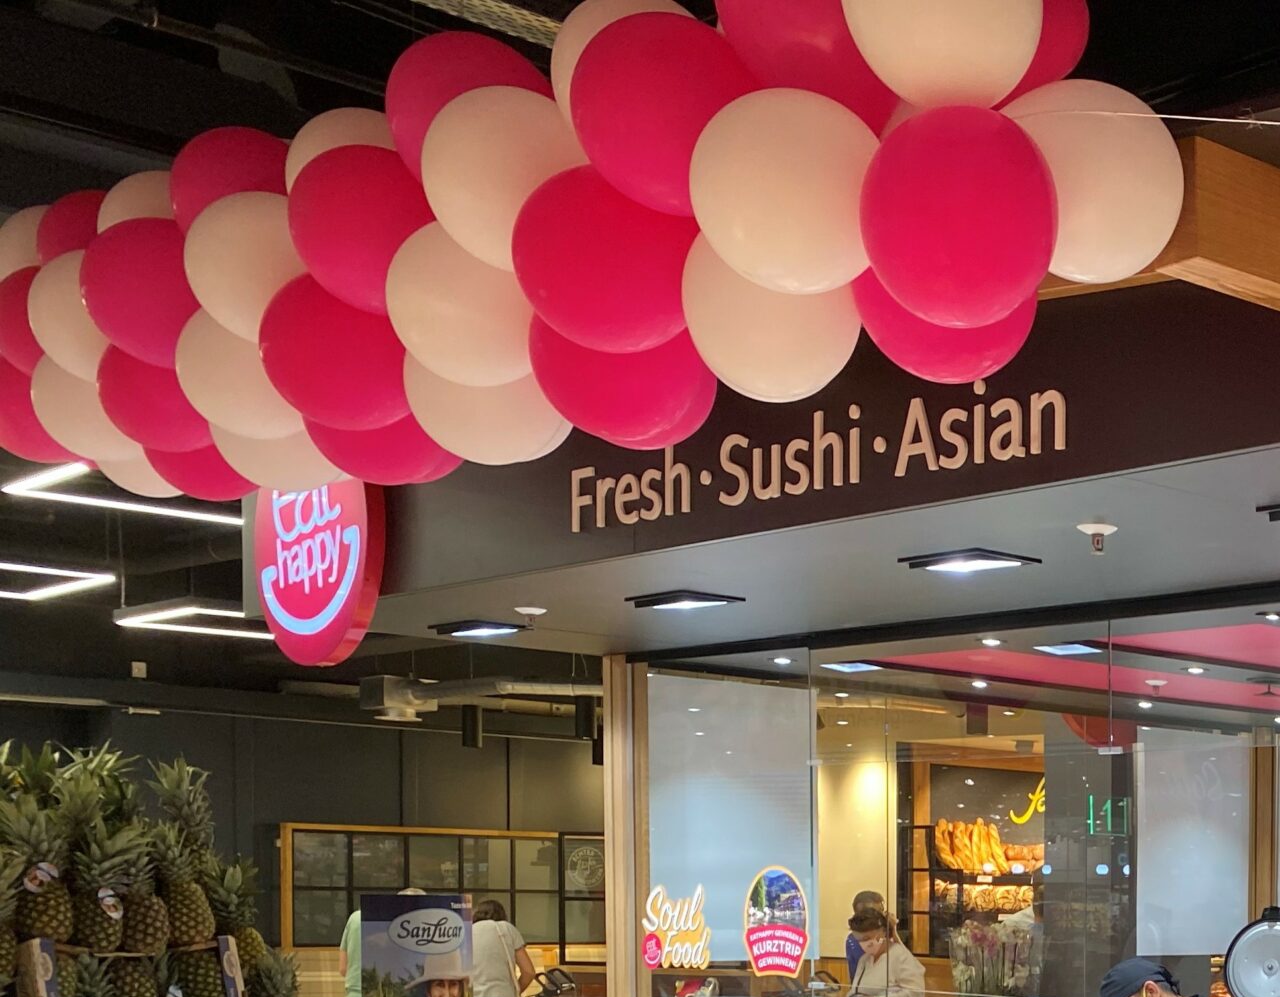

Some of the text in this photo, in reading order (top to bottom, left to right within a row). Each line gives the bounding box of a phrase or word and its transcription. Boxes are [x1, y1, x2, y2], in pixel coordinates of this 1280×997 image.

[570, 379, 1067, 533] Fresh Sushi Asian
[276, 524, 342, 594] happy
[642, 884, 703, 931] Soul
[397, 917, 463, 946] SanLucar
[661, 928, 710, 968] Food
[752, 939, 801, 957] KURZTRIP
[758, 957, 797, 970] GEWINNEN!
